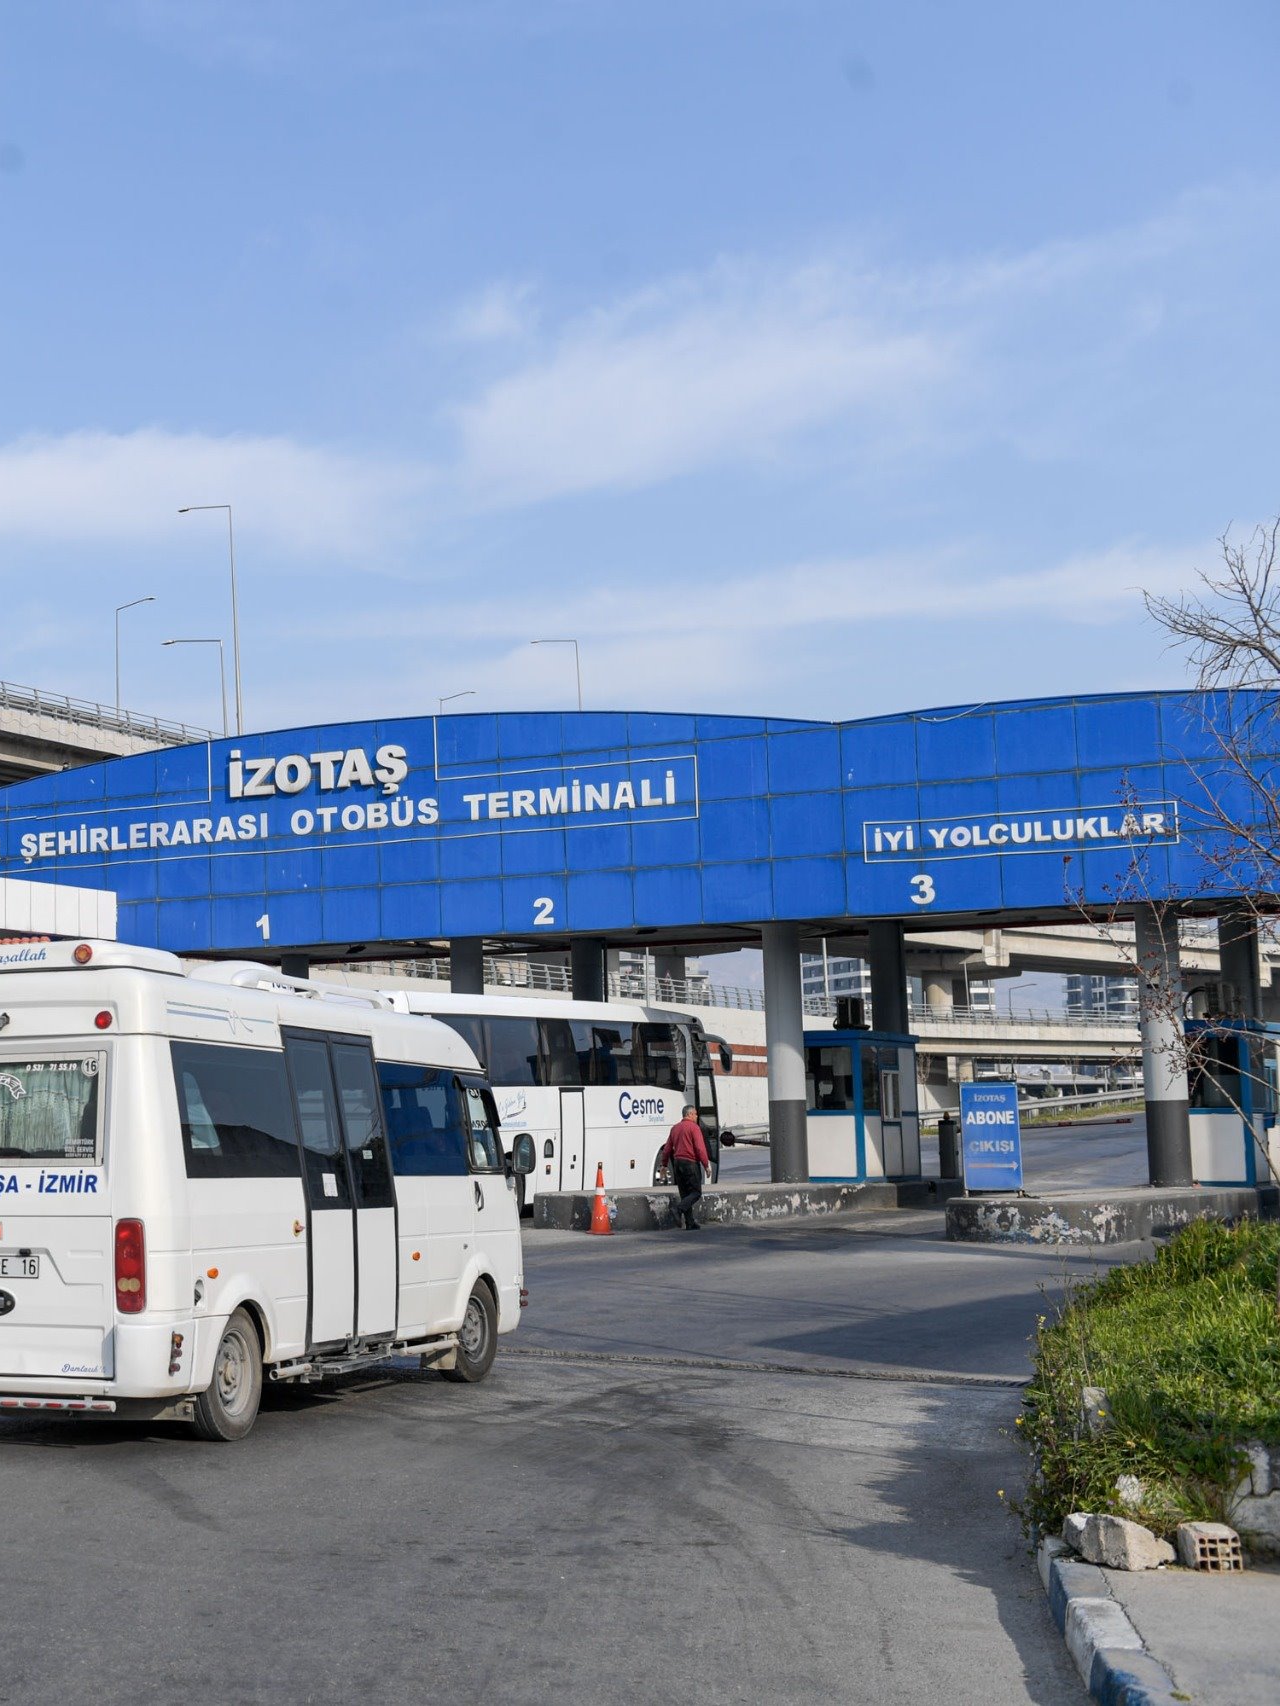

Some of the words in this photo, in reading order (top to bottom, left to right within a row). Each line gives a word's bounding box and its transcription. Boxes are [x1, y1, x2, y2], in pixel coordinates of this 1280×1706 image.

[229, 744, 409, 798] İZOTAŞ
[20, 812, 268, 862] ŞEHİRLERARASI
[290, 795, 439, 836] OTOBÜS
[463, 770, 676, 821] TERMİNALİ
[873, 825, 915, 852] İYİ
[928, 812, 1165, 850] YOLCULUKLAR
[910, 874, 936, 905] 3
[532, 897, 555, 925] 2
[255, 914, 271, 940] 1
[84, 1060, 97, 1072] 16
[973, 1093, 1006, 1103] İZOTAŞ
[965, 1110, 1016, 1125] ABONE
[969, 1140, 1015, 1155] ÇIKIŞI
[38, 1170, 99, 1193] İZMİR
[22, 1258, 37, 1276] 16
